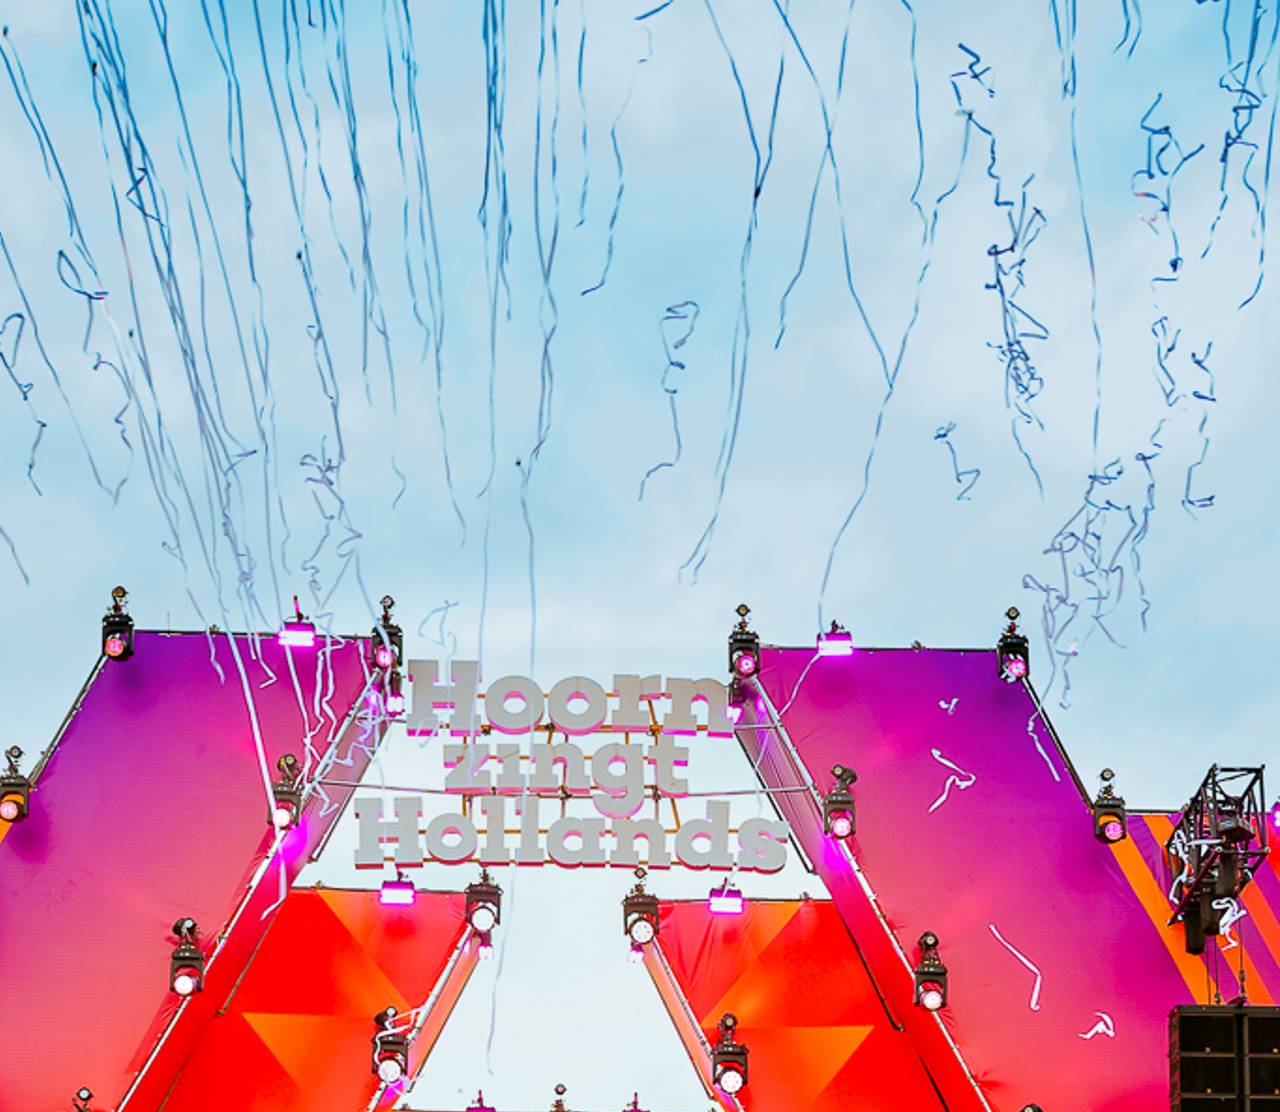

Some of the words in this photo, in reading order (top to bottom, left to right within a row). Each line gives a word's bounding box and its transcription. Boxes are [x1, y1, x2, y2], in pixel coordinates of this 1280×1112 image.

[406, 659, 734, 738] Hoorn
[443, 734, 689, 818] zingt
[354, 797, 788, 873] Hollands
